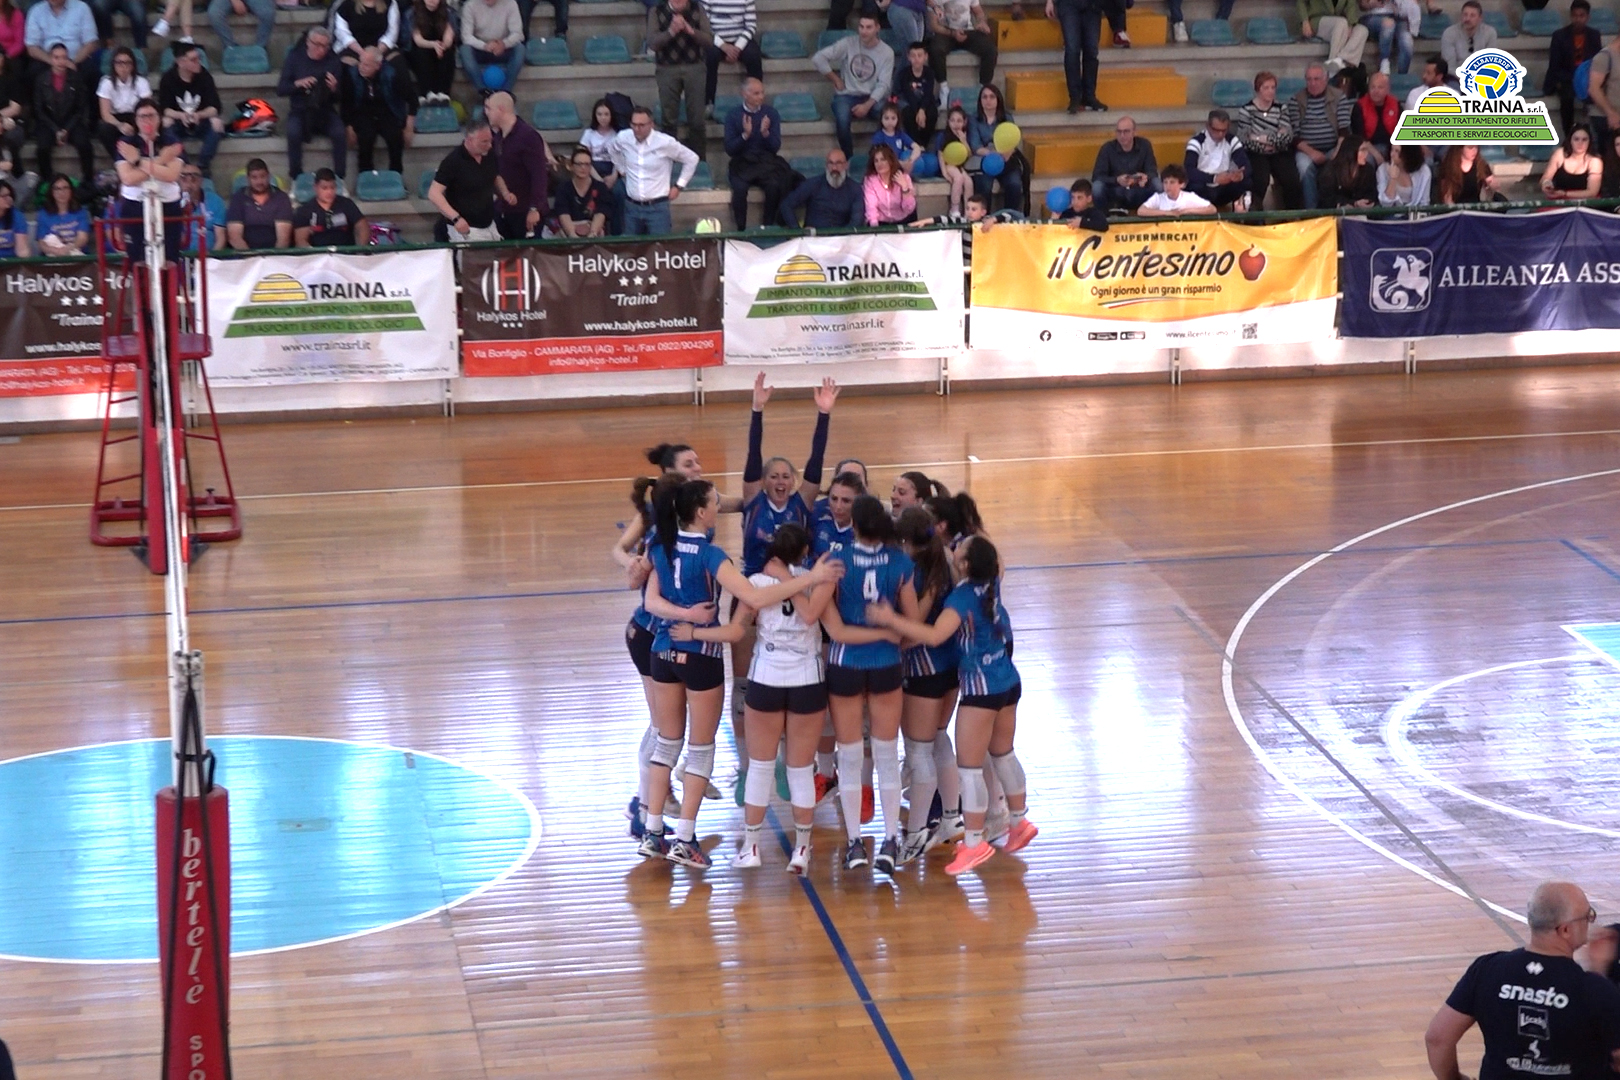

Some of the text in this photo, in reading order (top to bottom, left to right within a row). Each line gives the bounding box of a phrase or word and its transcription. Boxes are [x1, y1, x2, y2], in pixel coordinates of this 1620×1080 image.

[1114, 232, 1199, 243] SUPERMERCATI
[568, 250, 707, 277] Halykos Hotel
[1047, 234, 1236, 281] il Centesimo
[827, 262, 900, 282] TRAINA
[1438, 261, 1620, 288] ALLEANZA ASS
[6, 273, 94, 297] Halykos
[308, 282, 387, 300] TRAINA
[766, 284, 917, 298] IMPIANTO TRATTAMENTO RIFIUTI
[1090, 284, 1222, 299] Ogni giorno è un gran risparmio
[767, 299, 918, 314] TRASPORTI E SERVIZI ECOLOGICI
[477, 310, 547, 323] Halykos Hotel
[584, 318, 698, 332] www.halykos-hotel.it
[800, 318, 884, 332] www.trainasrl.it
[472, 350, 487, 358] Via
[488, 348, 526, 360] Bonfiglio
[534, 345, 594, 358] CAMMARATA
[594, 344, 614, 356] (AG)
[548, 356, 638, 367] info@halykos-hotel.it
[863, 569, 880, 603] 4
[1498, 983, 1570, 1009] snasto
